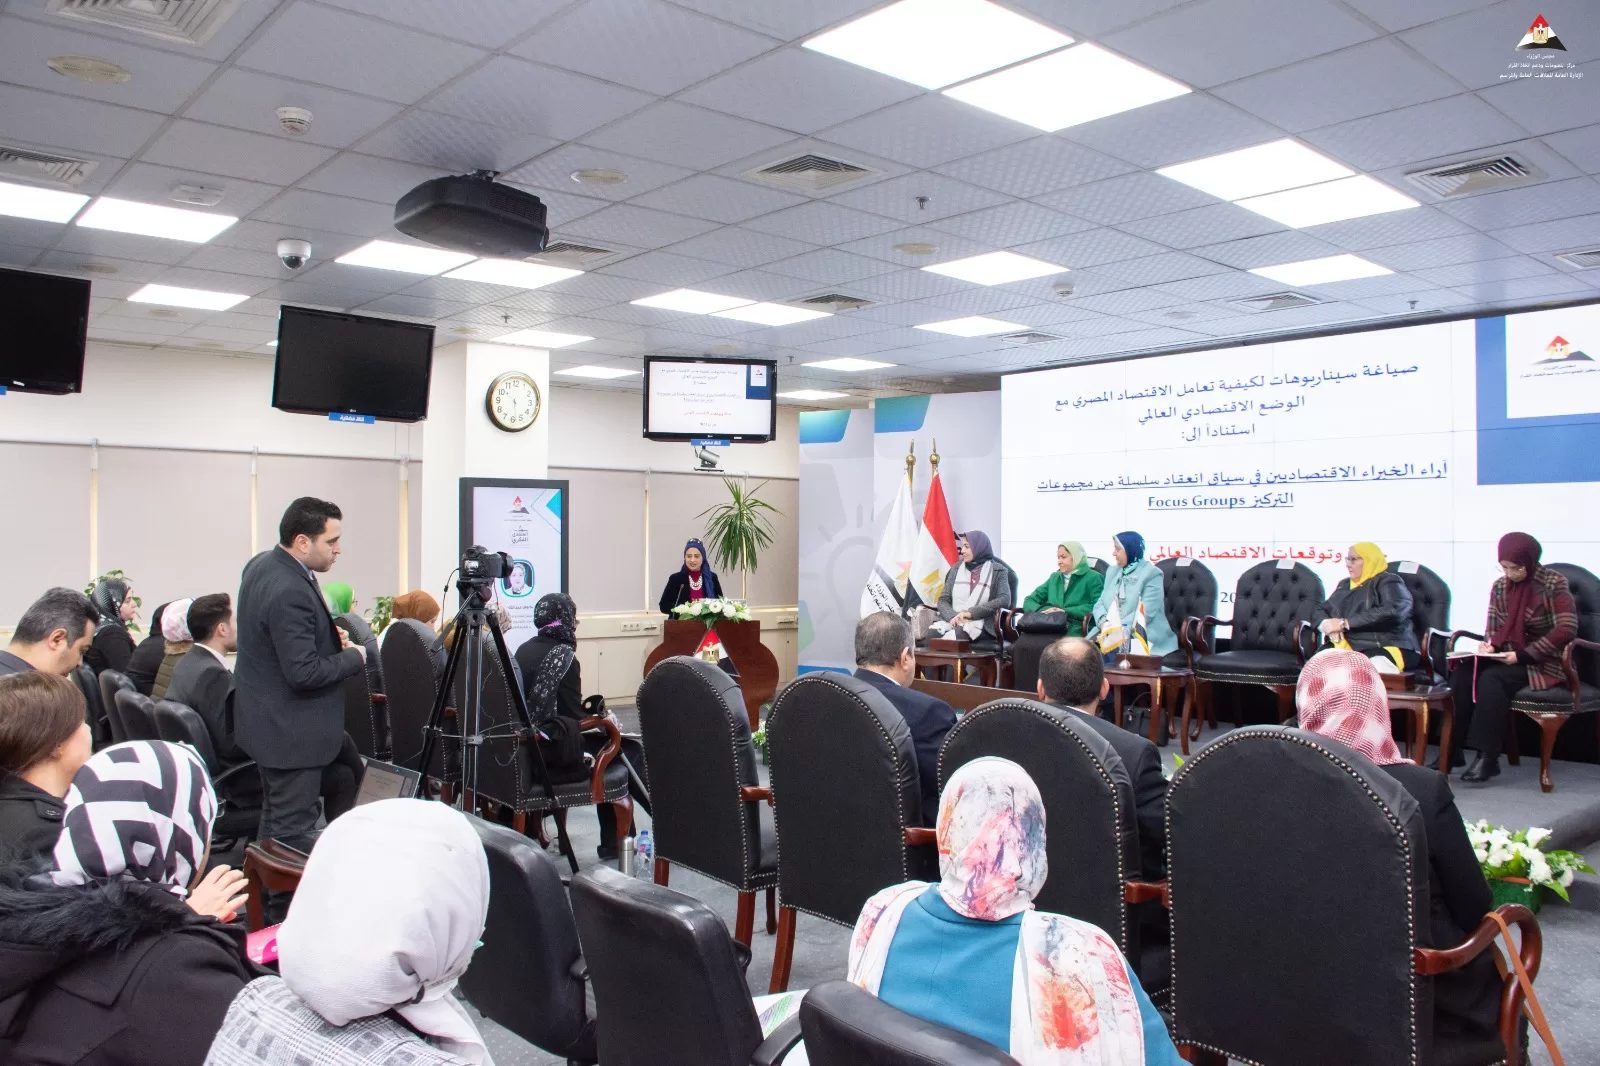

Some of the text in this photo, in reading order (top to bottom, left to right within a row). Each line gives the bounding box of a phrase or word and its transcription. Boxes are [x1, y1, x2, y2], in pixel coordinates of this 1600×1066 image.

[512, 380, 520, 388] 12
[1054, 363, 1419, 412] صياغة سيناريوهات لكيفية تعامل الاقتصاد المصري مع
[495, 396, 501, 404] 9
[527, 399, 532, 407] 3
[497, 405, 502, 413] 8
[1138, 395, 1305, 425] الوضع الاقتصادي العالمي
[510, 415, 516, 424] 6
[1037, 460, 1448, 492] آراء الخبراء الاقتصاديين في سياق انعقاد سلسلة من مجموعات
[1148, 492, 1294, 509] التركيز Focus Groups
[1149, 545, 1342, 564] وتوقعات الاقتصاد العالمي
